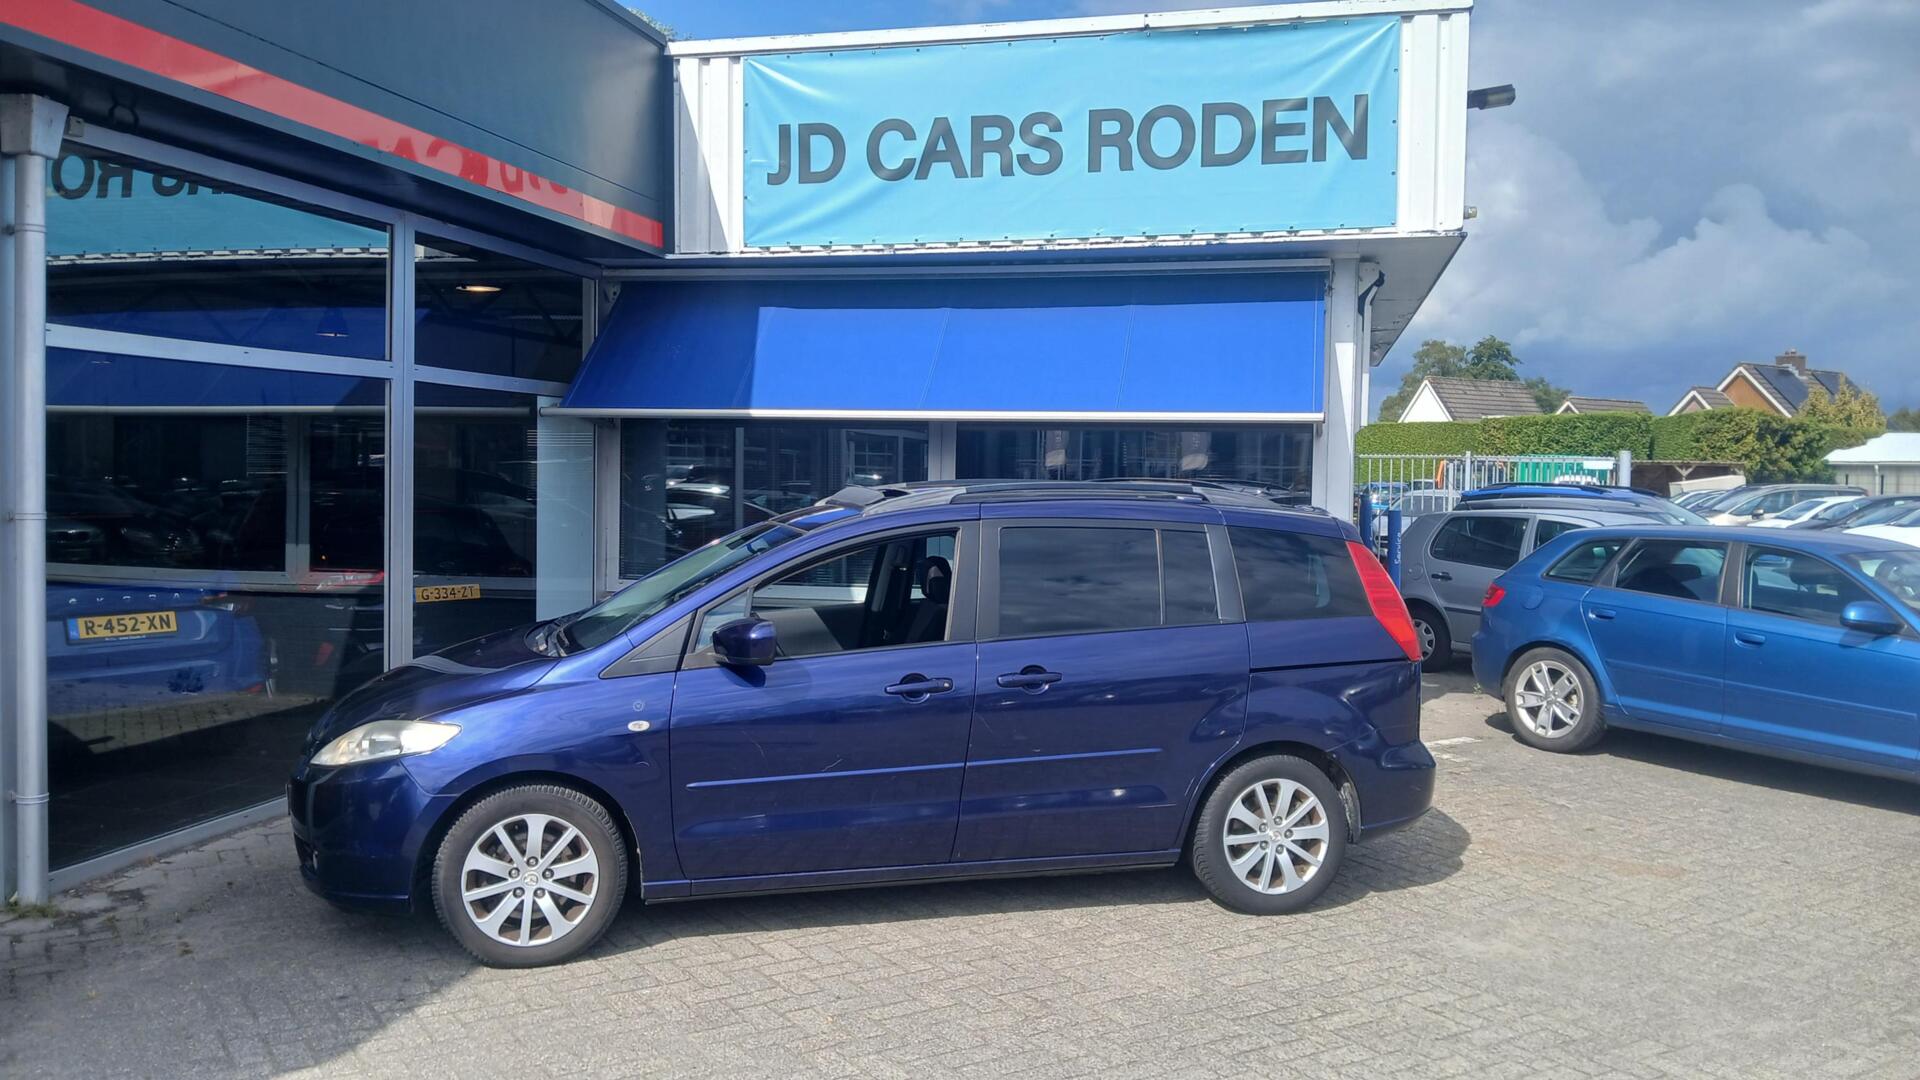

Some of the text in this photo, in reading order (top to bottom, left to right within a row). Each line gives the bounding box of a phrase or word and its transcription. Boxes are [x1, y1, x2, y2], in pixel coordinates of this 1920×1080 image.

[767, 93, 1369, 186] JD CARS RODEN
[421, 586, 474, 600] G-334-ZT
[84, 614, 171, 636] R-452-XN
